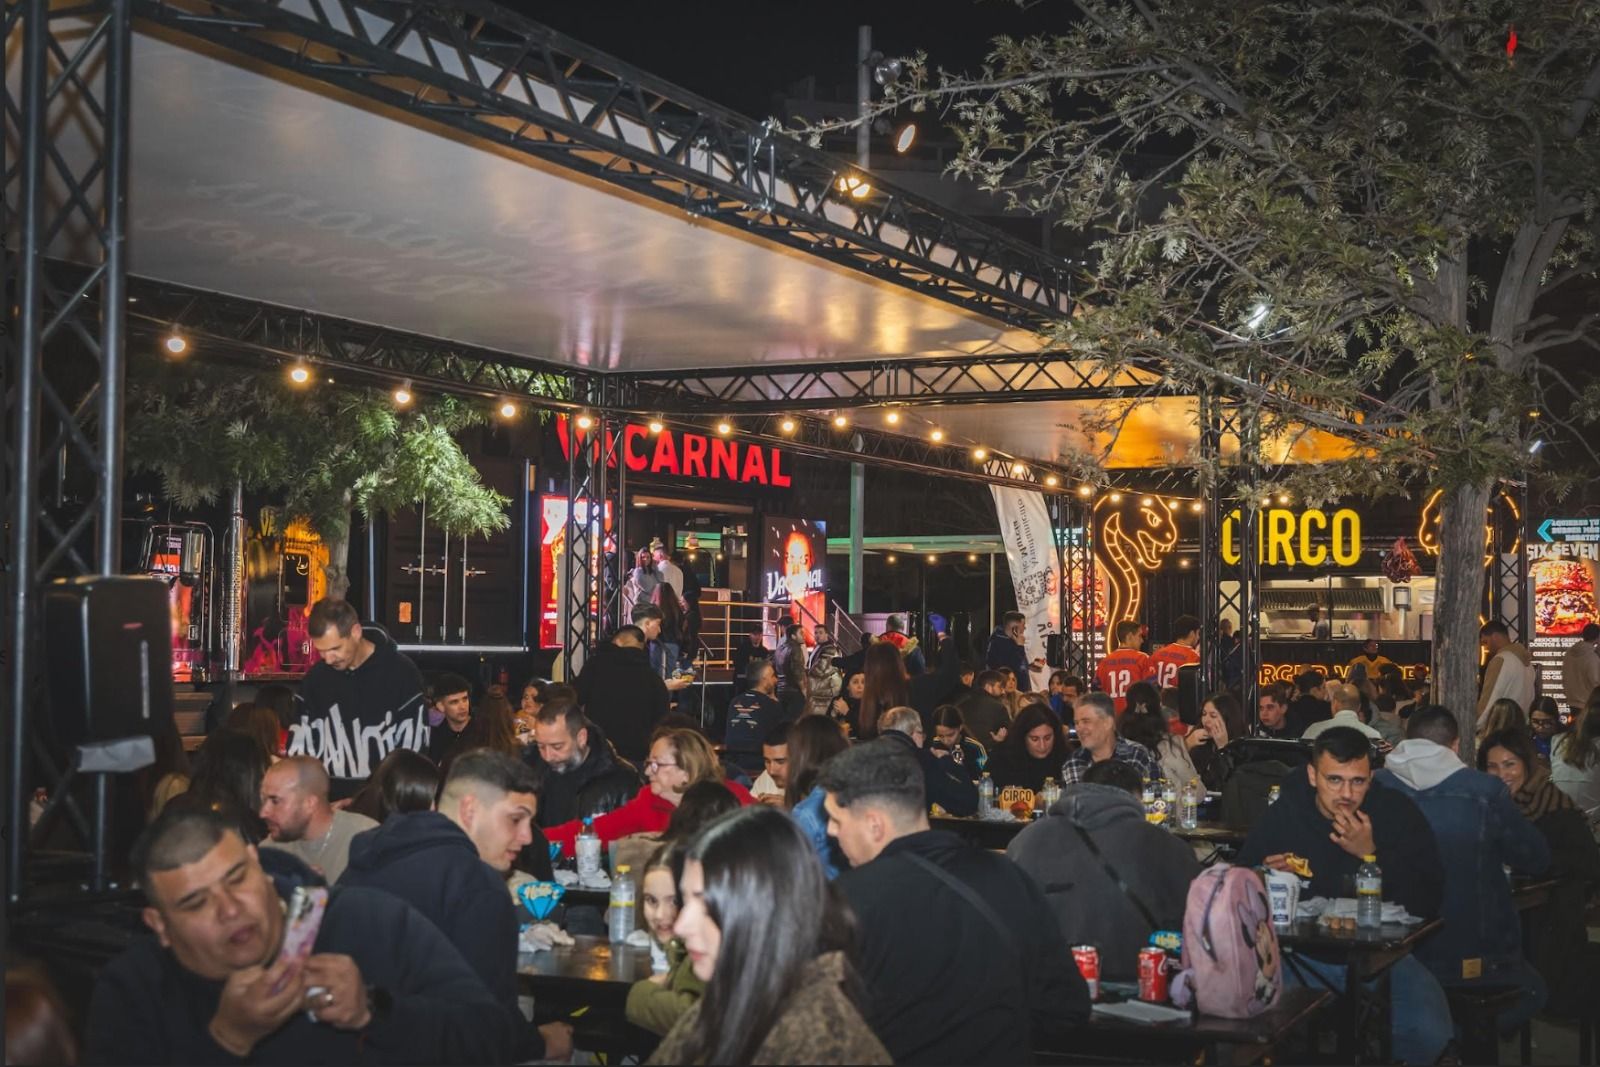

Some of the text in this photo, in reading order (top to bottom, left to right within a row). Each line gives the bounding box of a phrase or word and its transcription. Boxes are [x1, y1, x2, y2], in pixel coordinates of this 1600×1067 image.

[1222, 508, 1361, 566] CIRCO
[1526, 542, 1599, 561] SIX SEVEN
[1108, 669, 1131, 698] 12
[1157, 661, 1178, 689] 12
[1003, 790, 1032, 801] CIRCO
